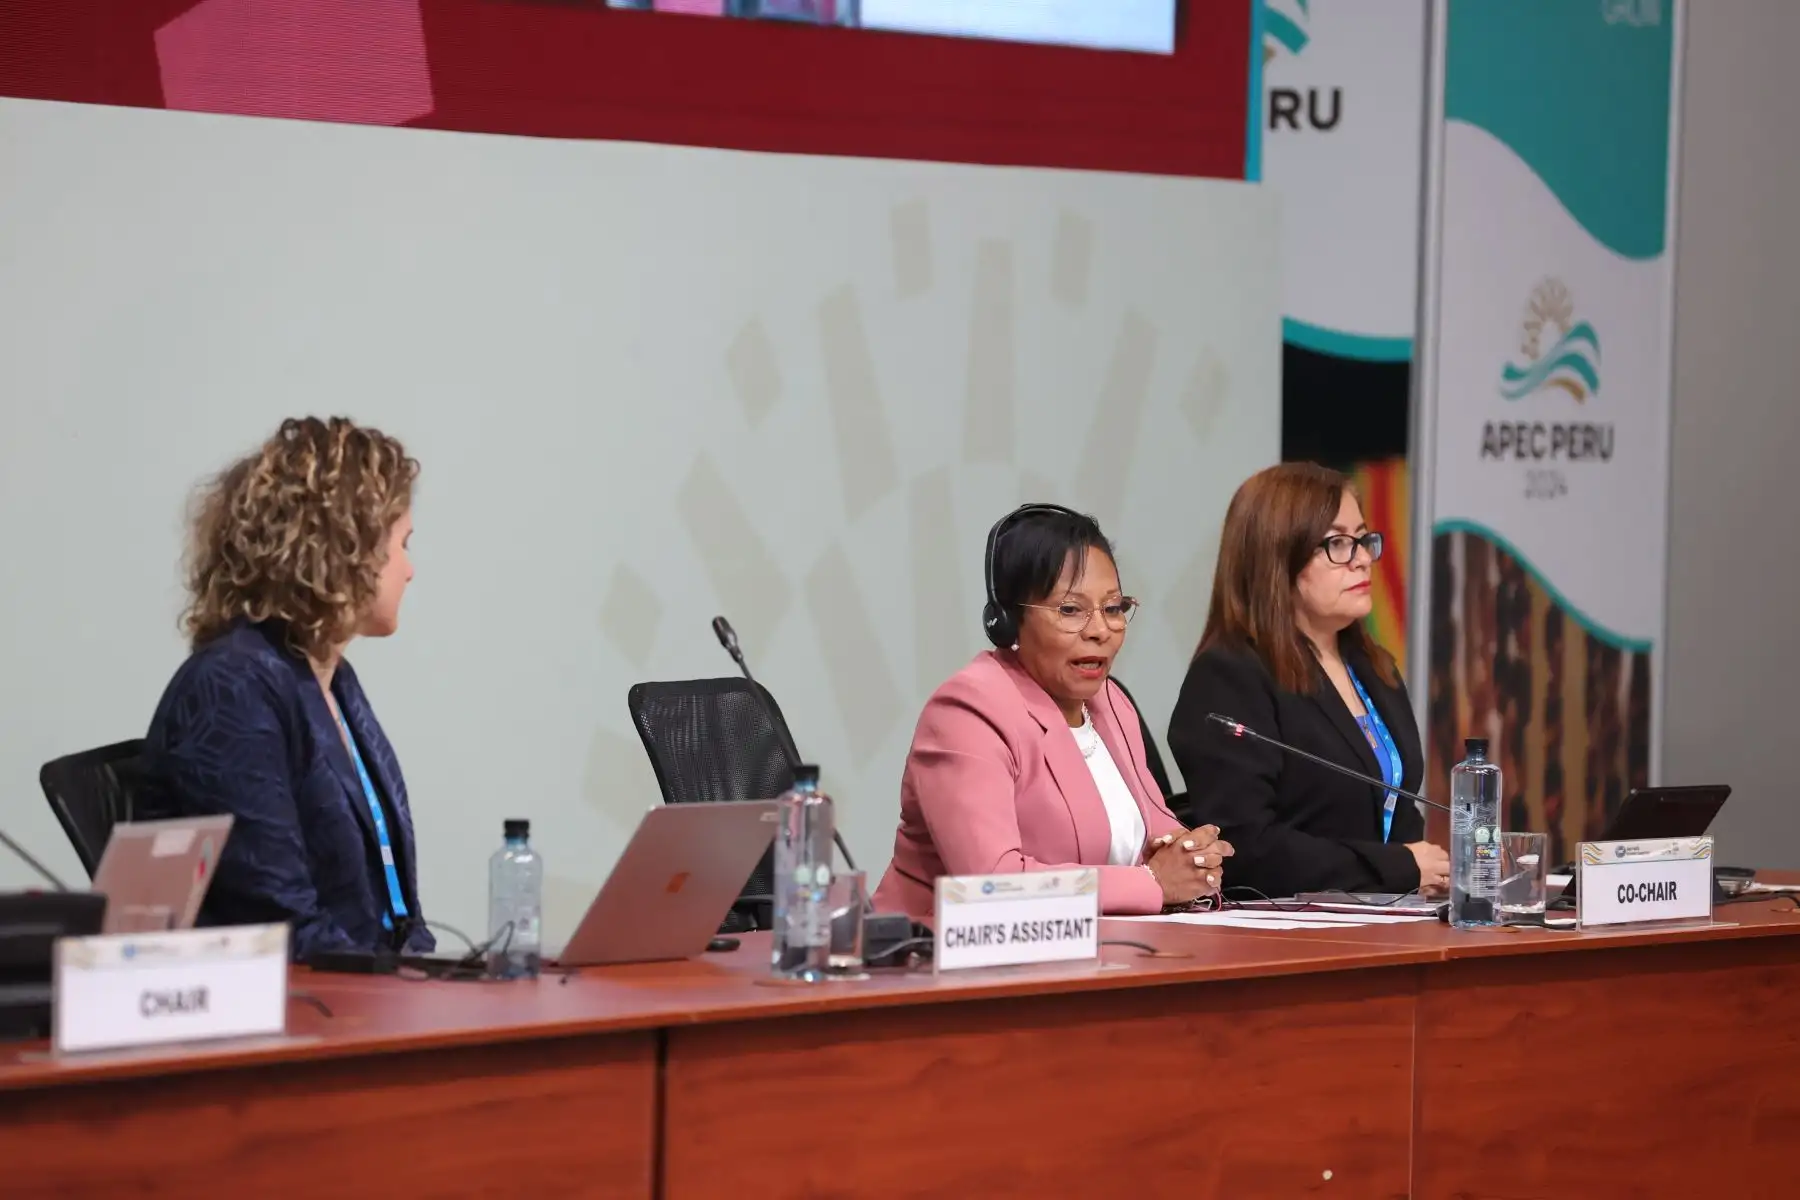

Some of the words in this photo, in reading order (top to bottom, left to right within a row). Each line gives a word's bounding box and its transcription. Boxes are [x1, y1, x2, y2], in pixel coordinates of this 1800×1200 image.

[1269, 88, 1341, 131] RU
[1480, 421, 1547, 461] APEC
[1552, 421, 1615, 462] PERU
[1617, 881, 1677, 904] CO-CHAIR
[944, 923, 1006, 948] CHAIR'S
[1010, 918, 1093, 943] ASSISTANT
[139, 986, 209, 1017] CHAIR
